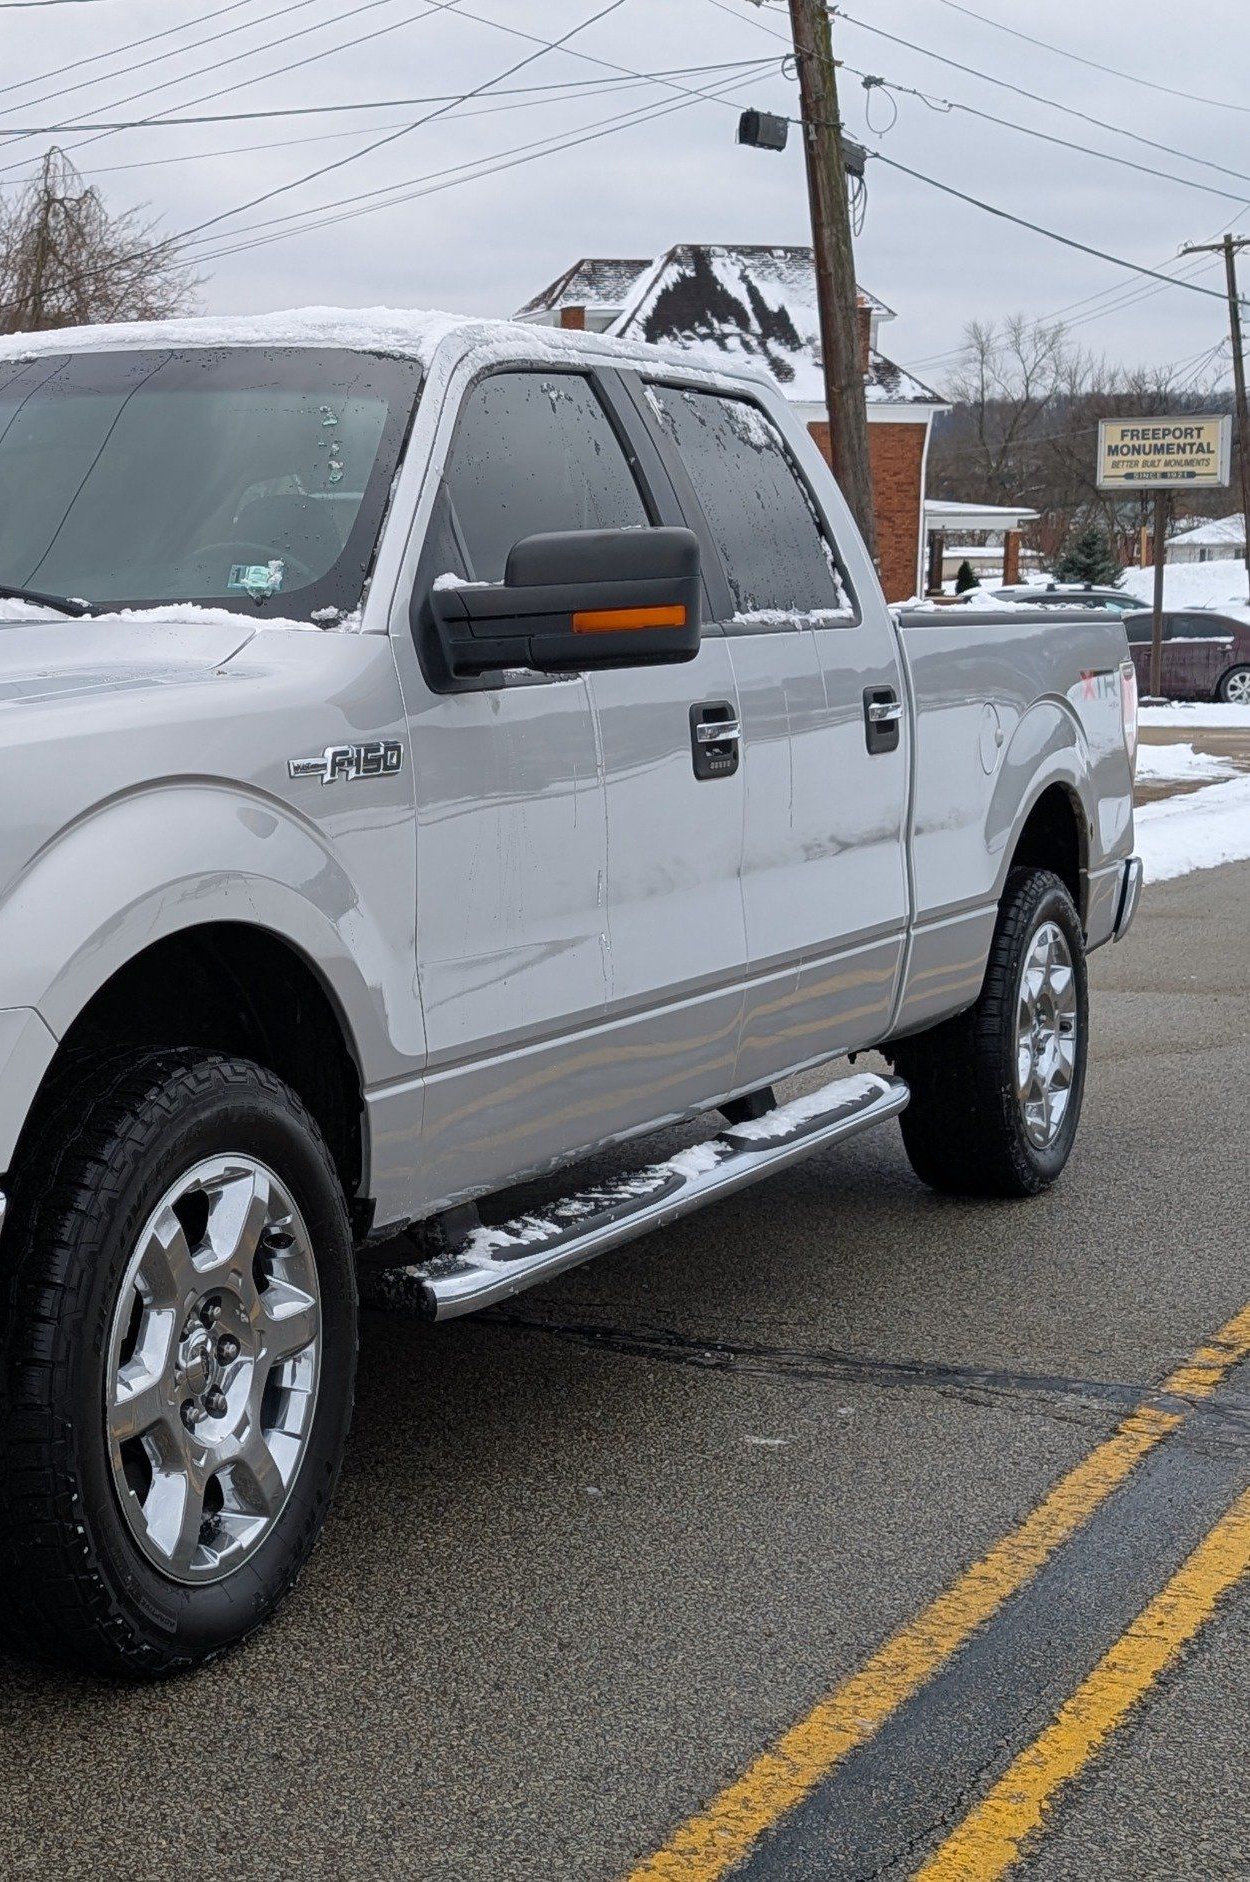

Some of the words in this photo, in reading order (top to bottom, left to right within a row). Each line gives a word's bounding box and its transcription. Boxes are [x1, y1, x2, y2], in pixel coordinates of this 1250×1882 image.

[1120, 427, 1204, 441] FREEPORT
[1107, 442, 1215, 457] MONUMENTAL
[1111, 459, 1139, 469] BETTER
[1141, 459, 1161, 468] BUILT
[1163, 458, 1211, 468] MONUMENTS
[1133, 472, 1161, 480] SINCE
